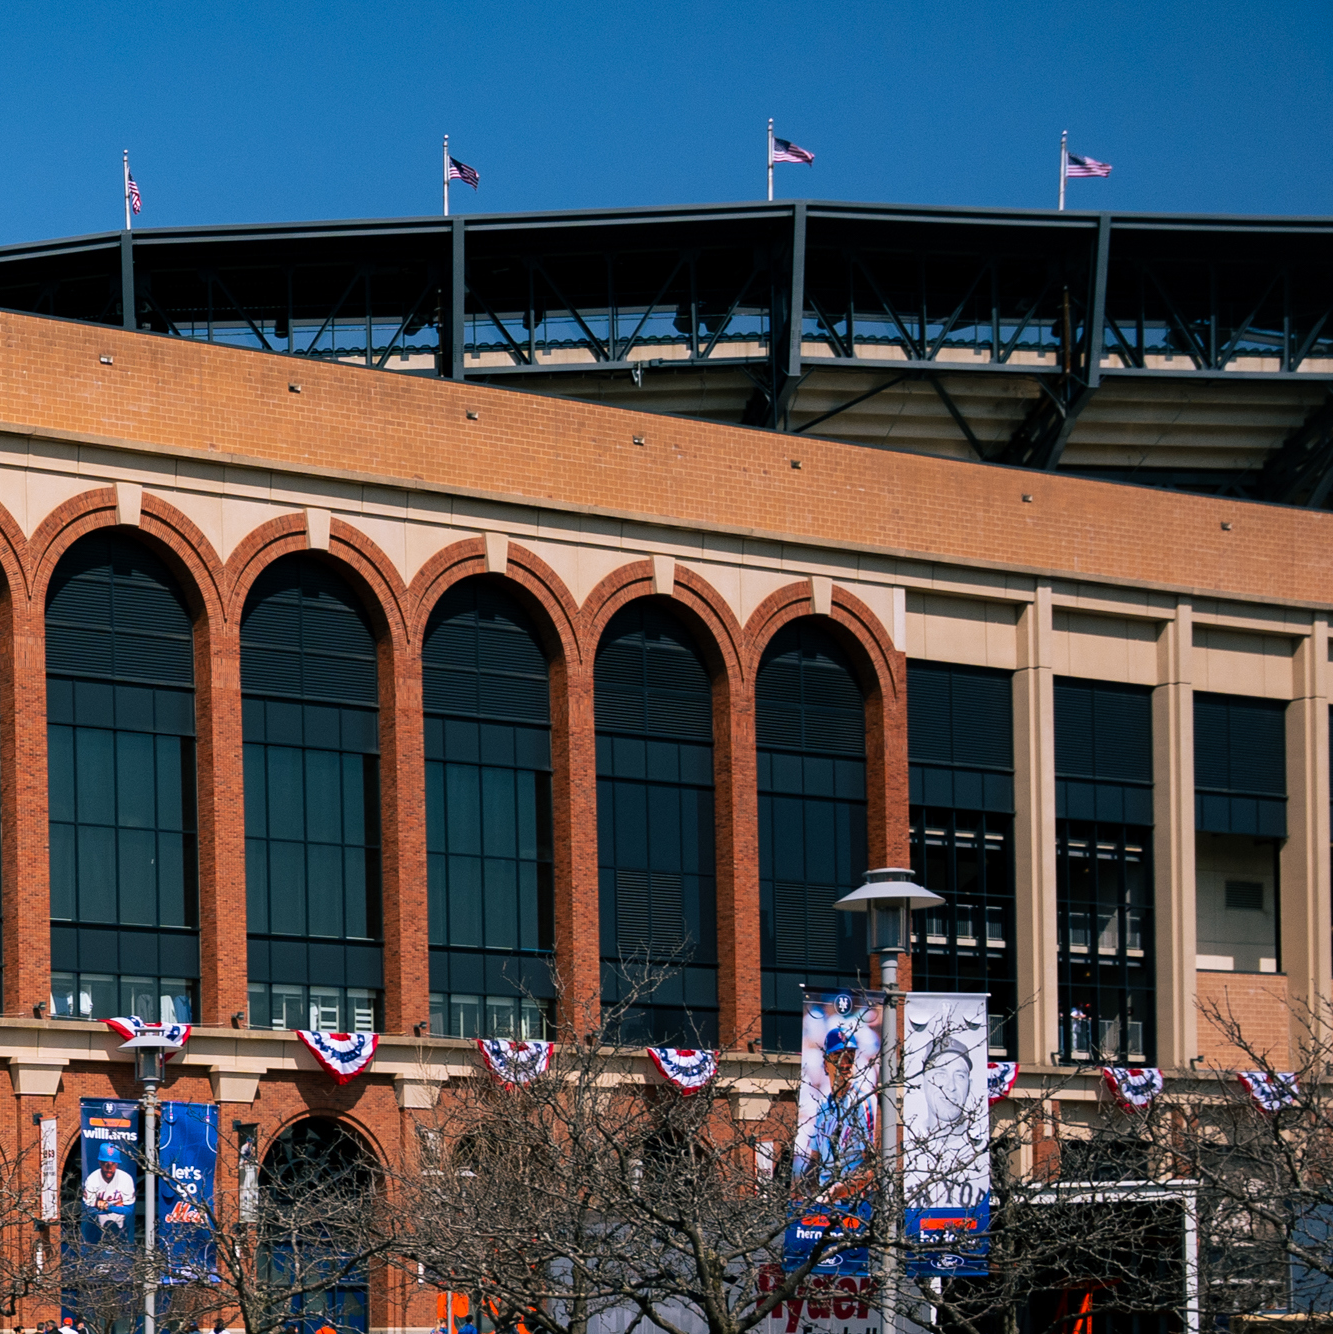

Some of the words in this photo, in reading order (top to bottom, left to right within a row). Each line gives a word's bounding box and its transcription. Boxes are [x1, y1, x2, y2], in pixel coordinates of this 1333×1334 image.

[82, 1127, 137, 1142] williams
[171, 1164, 202, 1180] let's
[177, 1182, 197, 1198] go
